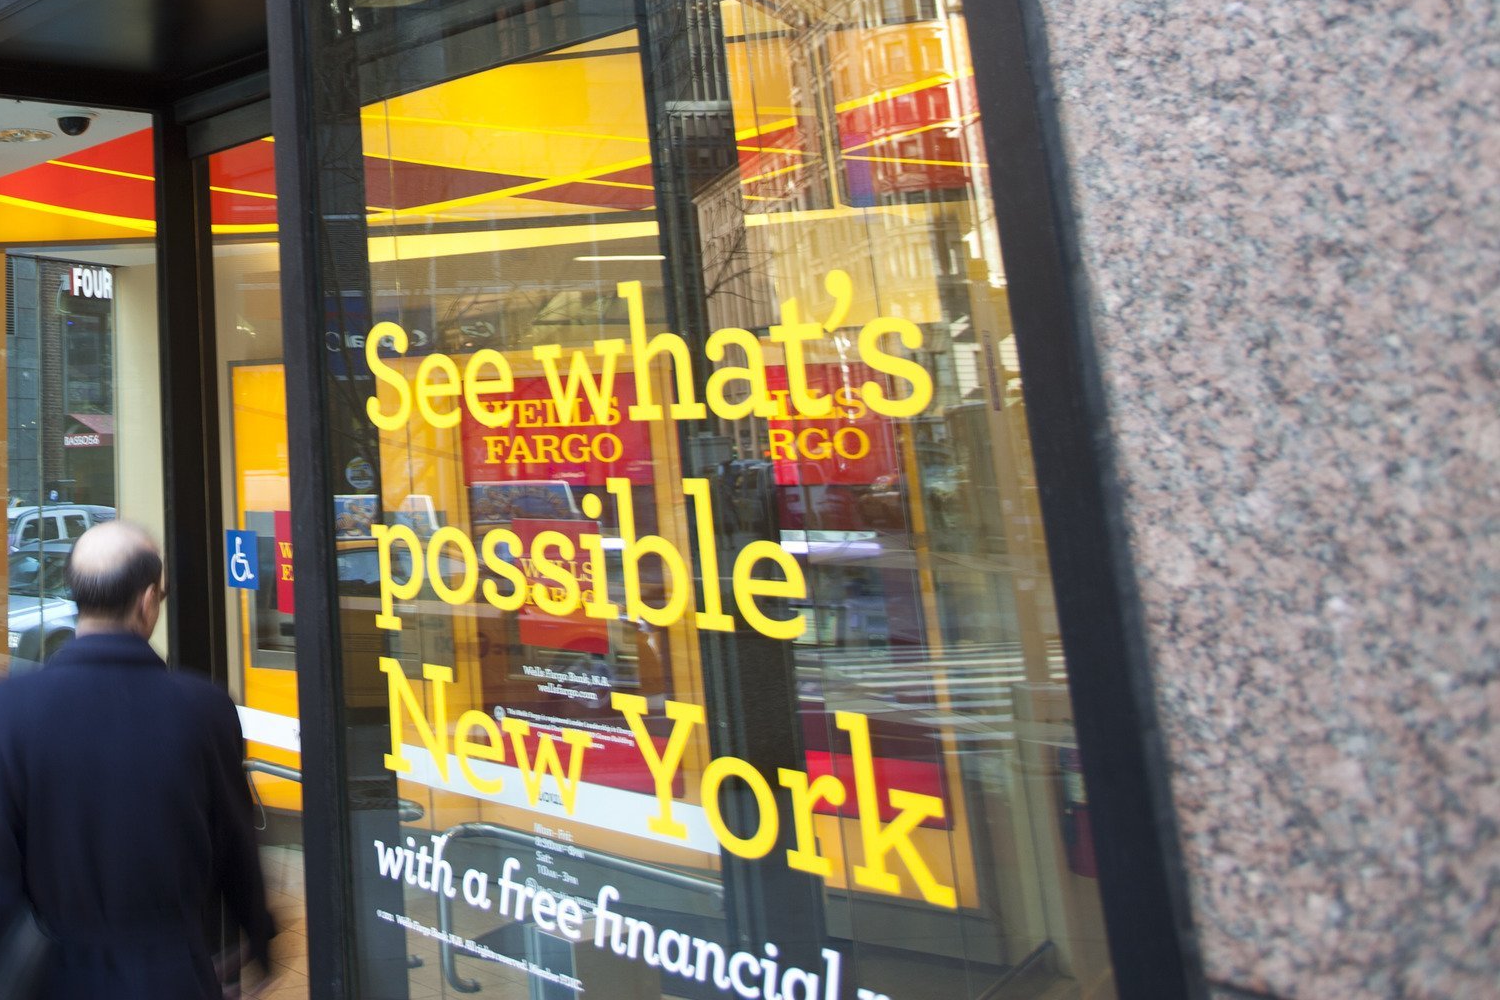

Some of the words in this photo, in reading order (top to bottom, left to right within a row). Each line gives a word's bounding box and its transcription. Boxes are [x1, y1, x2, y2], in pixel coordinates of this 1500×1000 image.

[70, 266, 113, 300] FOUR
[366, 321, 514, 431] See
[533, 270, 933, 422] what's
[483, 432, 623, 464] FARGO
[768, 427, 871, 460] RGO
[371, 478, 807, 640] possible
[522, 665, 545, 677] Wells
[545, 668, 567, 683] Fargo
[378, 656, 592, 815] New
[611, 692, 957, 909] York
[373, 834, 456, 898] with
[463, 868, 492, 910] a
[498, 857, 583, 940] free
[592, 884, 842, 1000] financial
